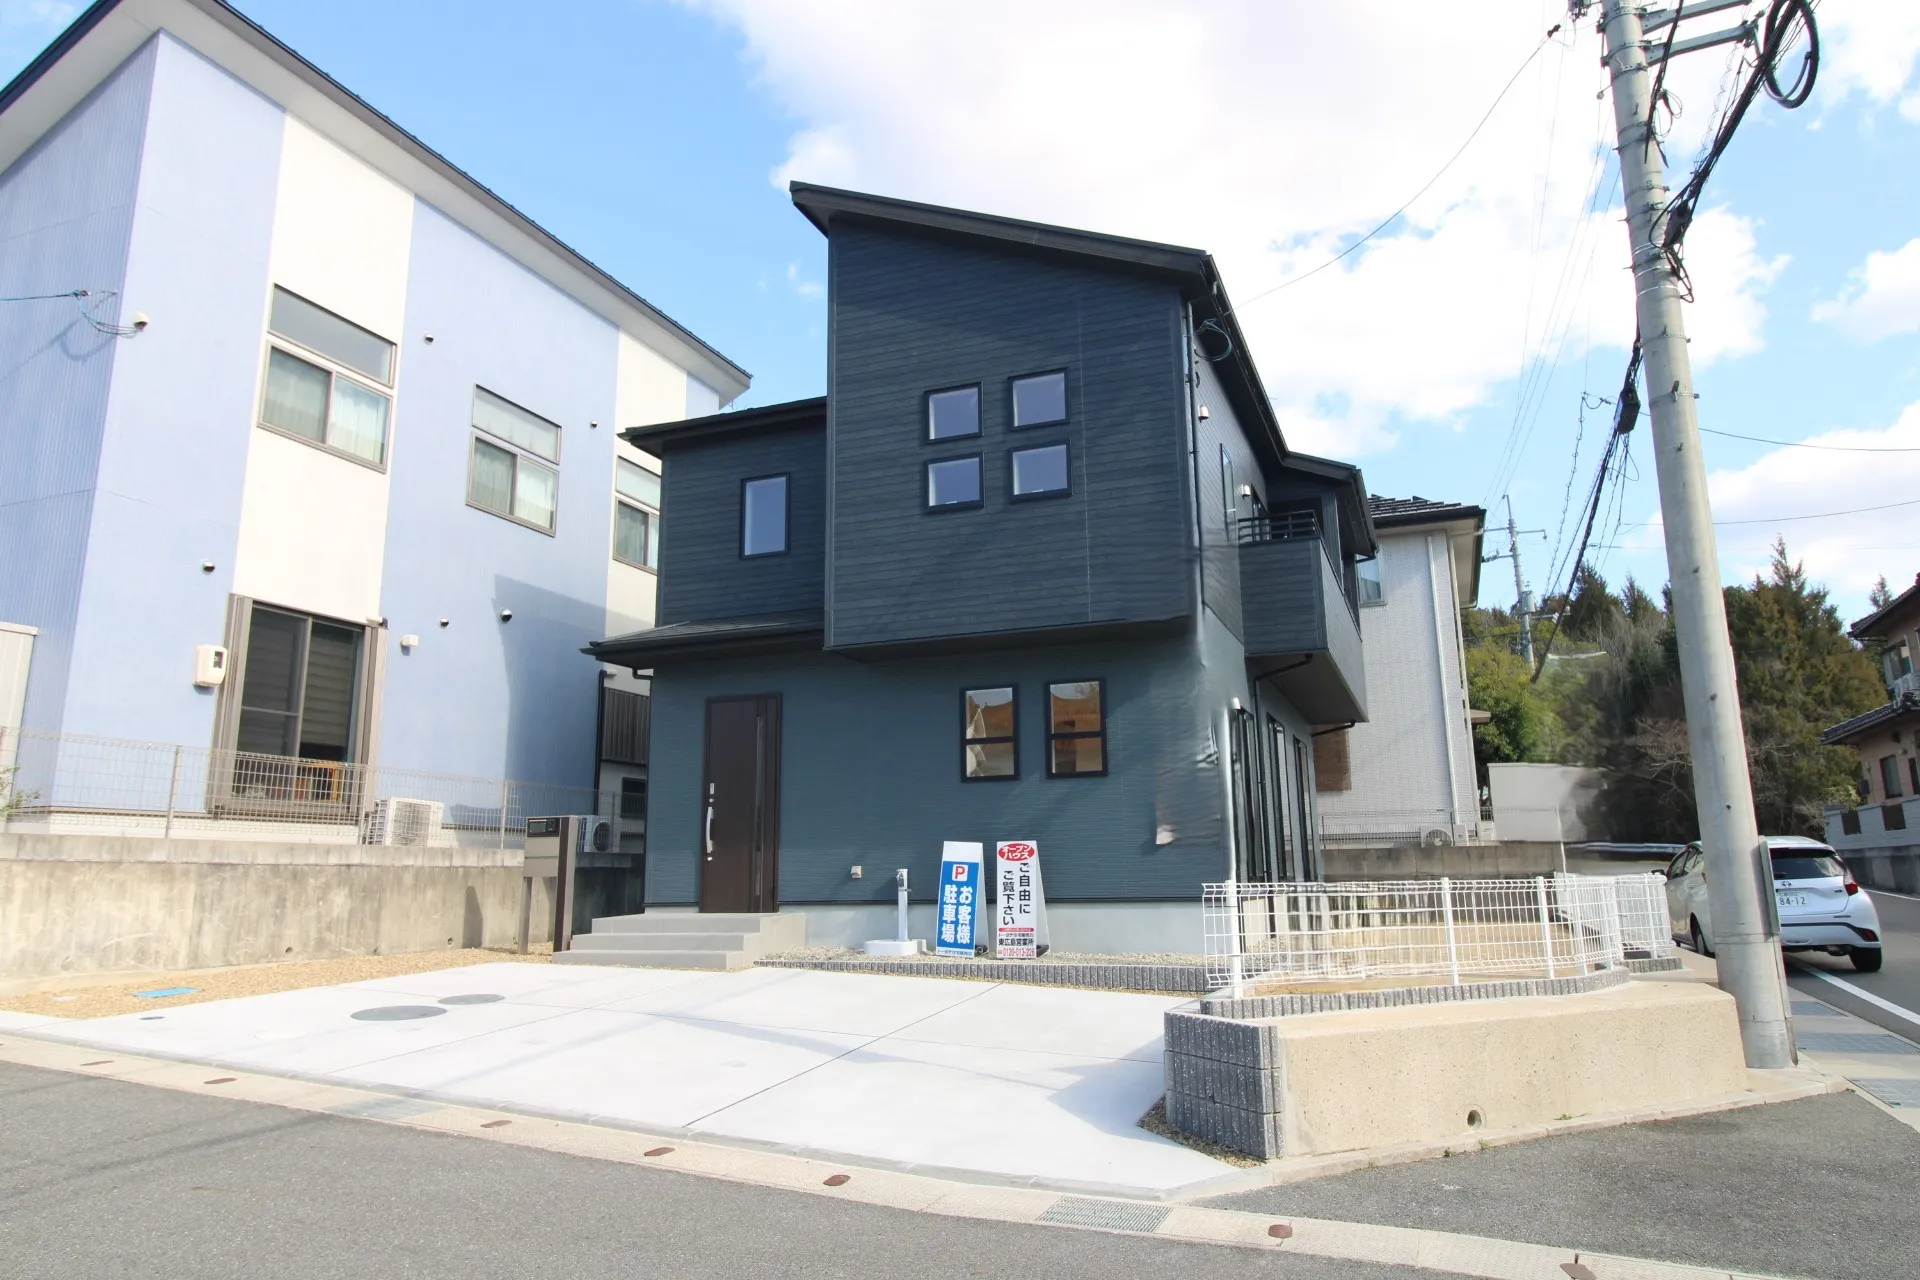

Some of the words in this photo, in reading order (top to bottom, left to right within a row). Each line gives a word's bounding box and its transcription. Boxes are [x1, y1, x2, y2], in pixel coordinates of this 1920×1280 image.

[1002, 845, 1031, 853] オープン
[1003, 851, 1030, 860] ハウス
[955, 866, 965, 879] P
[1019, 863, 1031, 914] ご自由に
[1002, 871, 1015, 925] ご覧下さい
[1779, 897, 1806, 906] 84-12
[941, 885, 957, 943] 駐車場
[957, 886, 973, 944] お客様
[998, 938, 1034, 946] 東広島営業所
